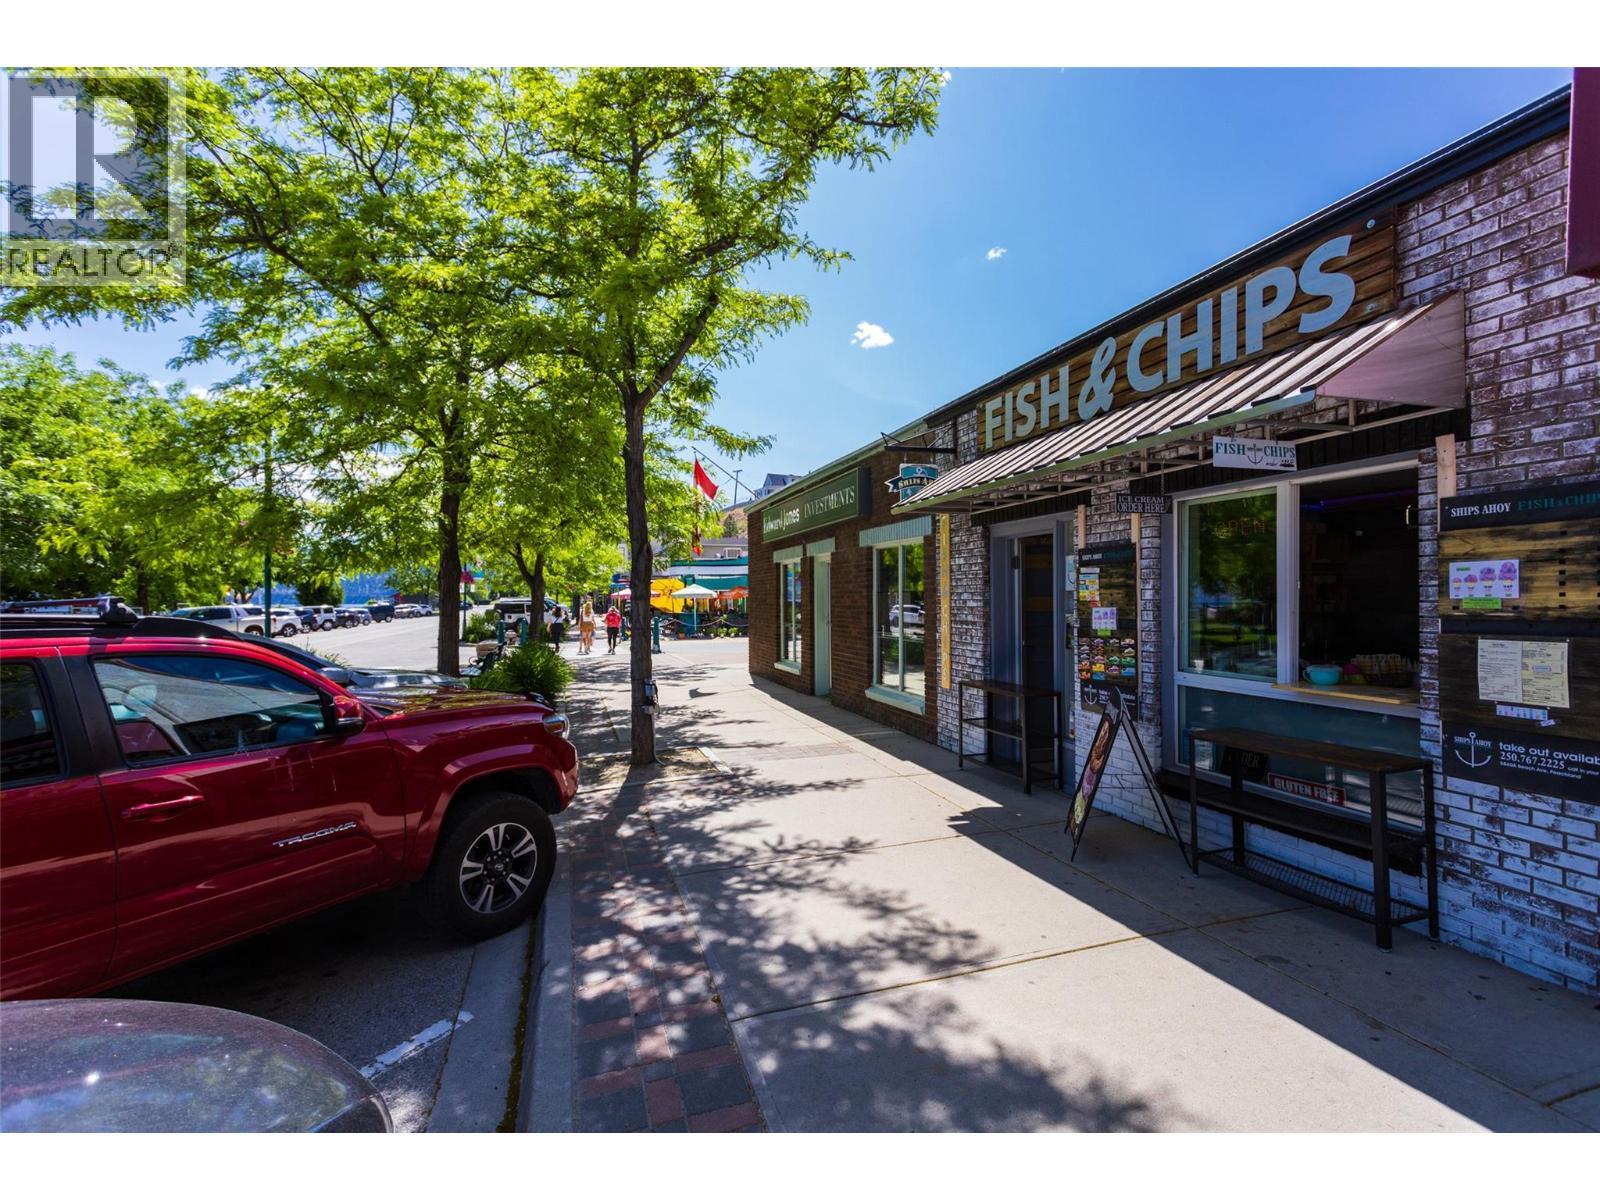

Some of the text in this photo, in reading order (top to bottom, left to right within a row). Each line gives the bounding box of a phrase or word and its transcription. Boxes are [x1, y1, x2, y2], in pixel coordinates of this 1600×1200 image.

[985, 235, 1356, 449] FISH & CHIPS
[1215, 442, 1296, 458] FISH CHIPS
[804, 486, 855, 518] INVESTMENTS
[1134, 495, 1164, 504] CREAM
[1517, 498, 1554, 511] FISH
[1117, 503, 1165, 513] ORDER HERE
[1450, 502, 1512, 518] SHIPS AHOY
[1499, 741, 1526, 754] take
[1528, 748, 1550, 757] out
[1500, 751, 1565, 770] 250.767.2225
[1274, 777, 1340, 803] GLUTEN FREE
[272, 821, 357, 848] TACOMA
